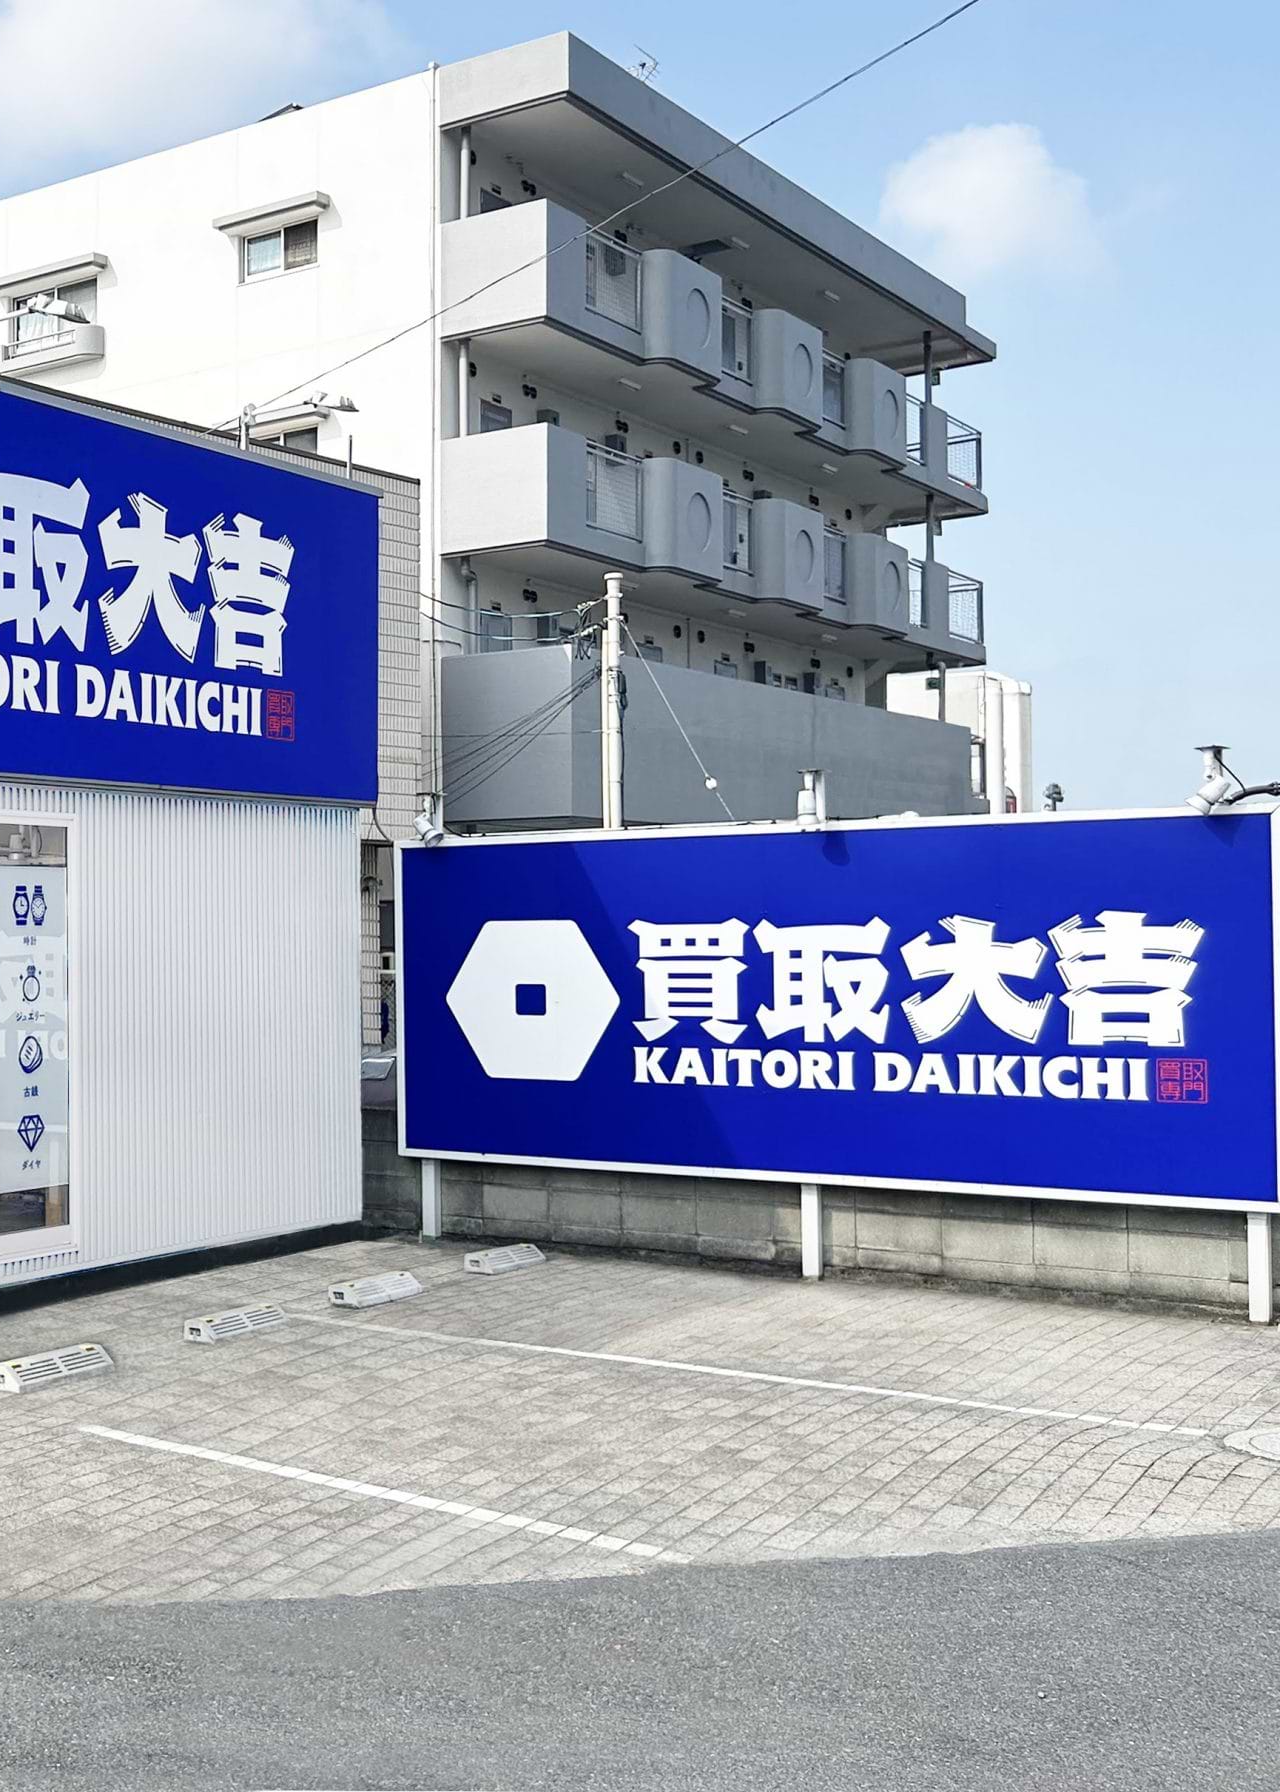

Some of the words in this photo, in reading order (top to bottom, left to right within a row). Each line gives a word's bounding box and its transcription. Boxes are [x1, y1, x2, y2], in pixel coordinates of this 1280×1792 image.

[75, 664, 262, 736] DAIKICHI
[23, 936, 37, 946] 時計
[627, 911, 1205, 1047] 買取大吉
[15, 1010, 46, 1022] ジュエリー
[634, 1046, 856, 1091] KAITORI
[873, 1052, 1150, 1102] DAIKICHI
[22, 1159, 41, 1171] ダイヤ
